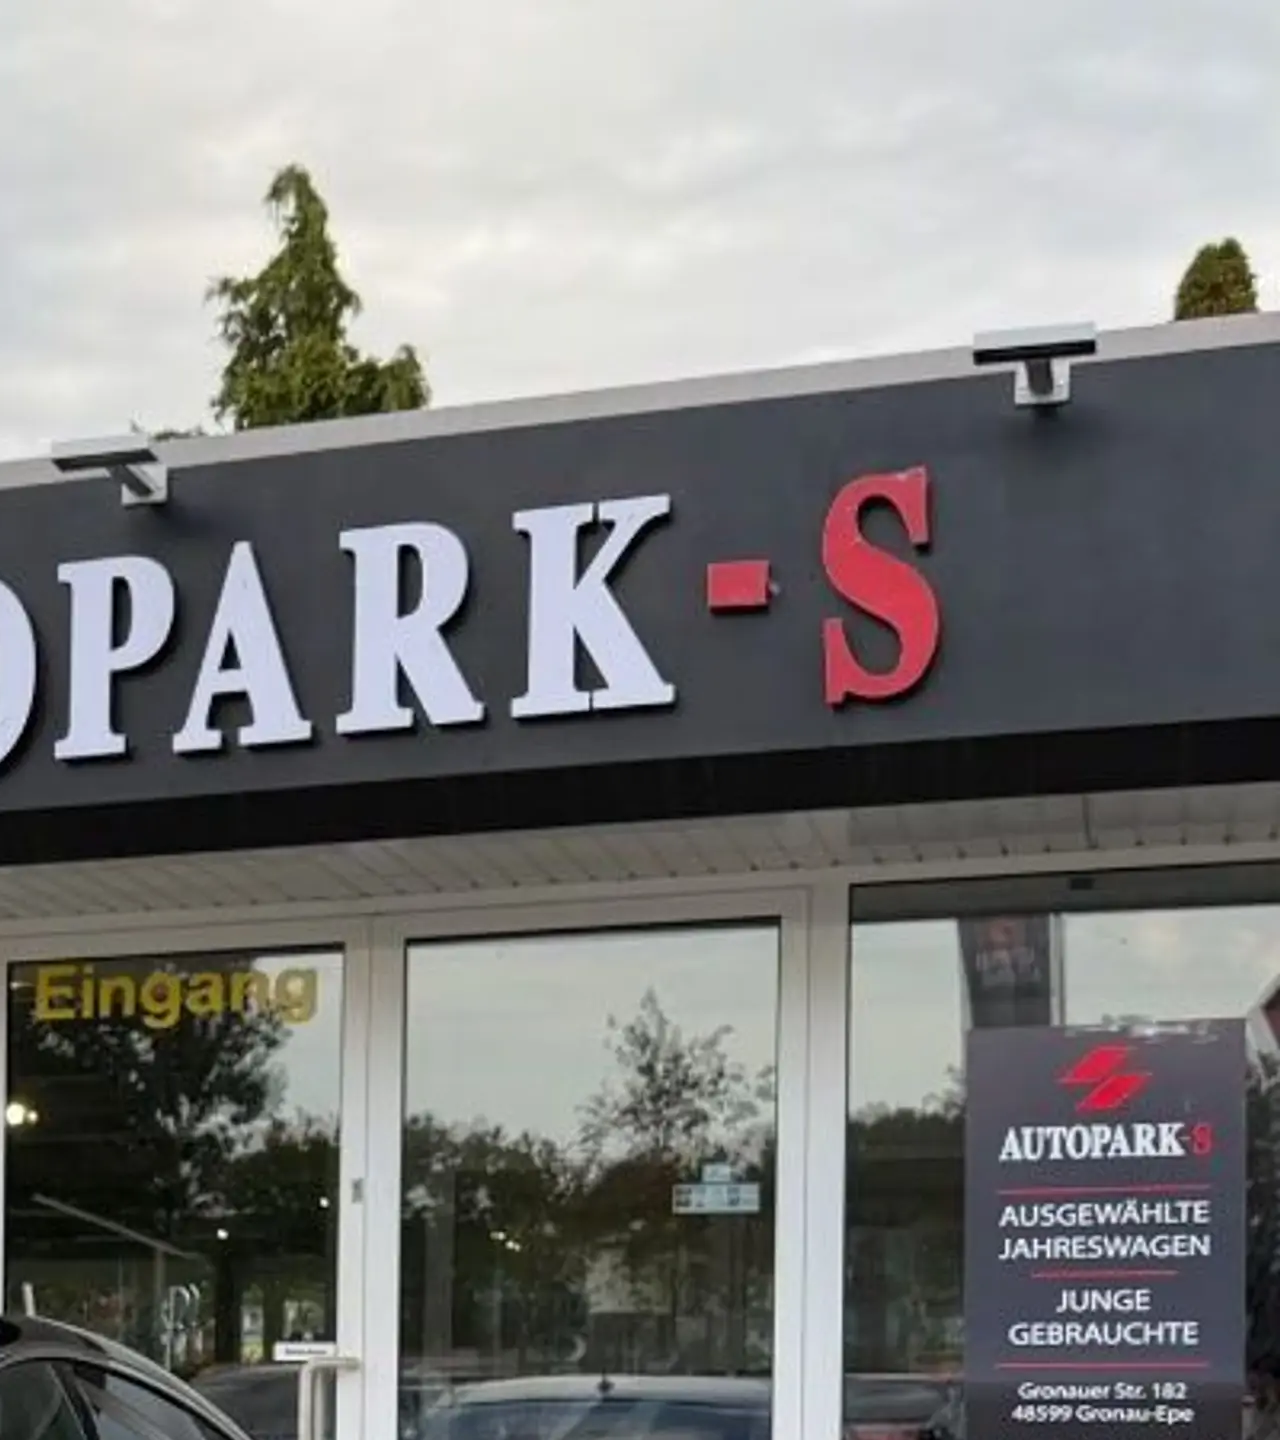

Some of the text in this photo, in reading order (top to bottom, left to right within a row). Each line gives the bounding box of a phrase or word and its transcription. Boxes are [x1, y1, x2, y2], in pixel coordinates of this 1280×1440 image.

[37, 961, 321, 1029] Eingang
[999, 1122, 1213, 1161] AUTOPARK-S
[998, 1198, 1211, 1228] AUSGEWÄHLTE
[998, 1234, 1211, 1260] JAHRESWAGEN
[1056, 1289, 1152, 1313] JUNGE
[1008, 1321, 1200, 1346] GEBRAUCHTE
[1018, 1382, 1187, 1400] Gronauer Str. 182
[1011, 1404, 1195, 1425] 48599 Gronau-Epe
